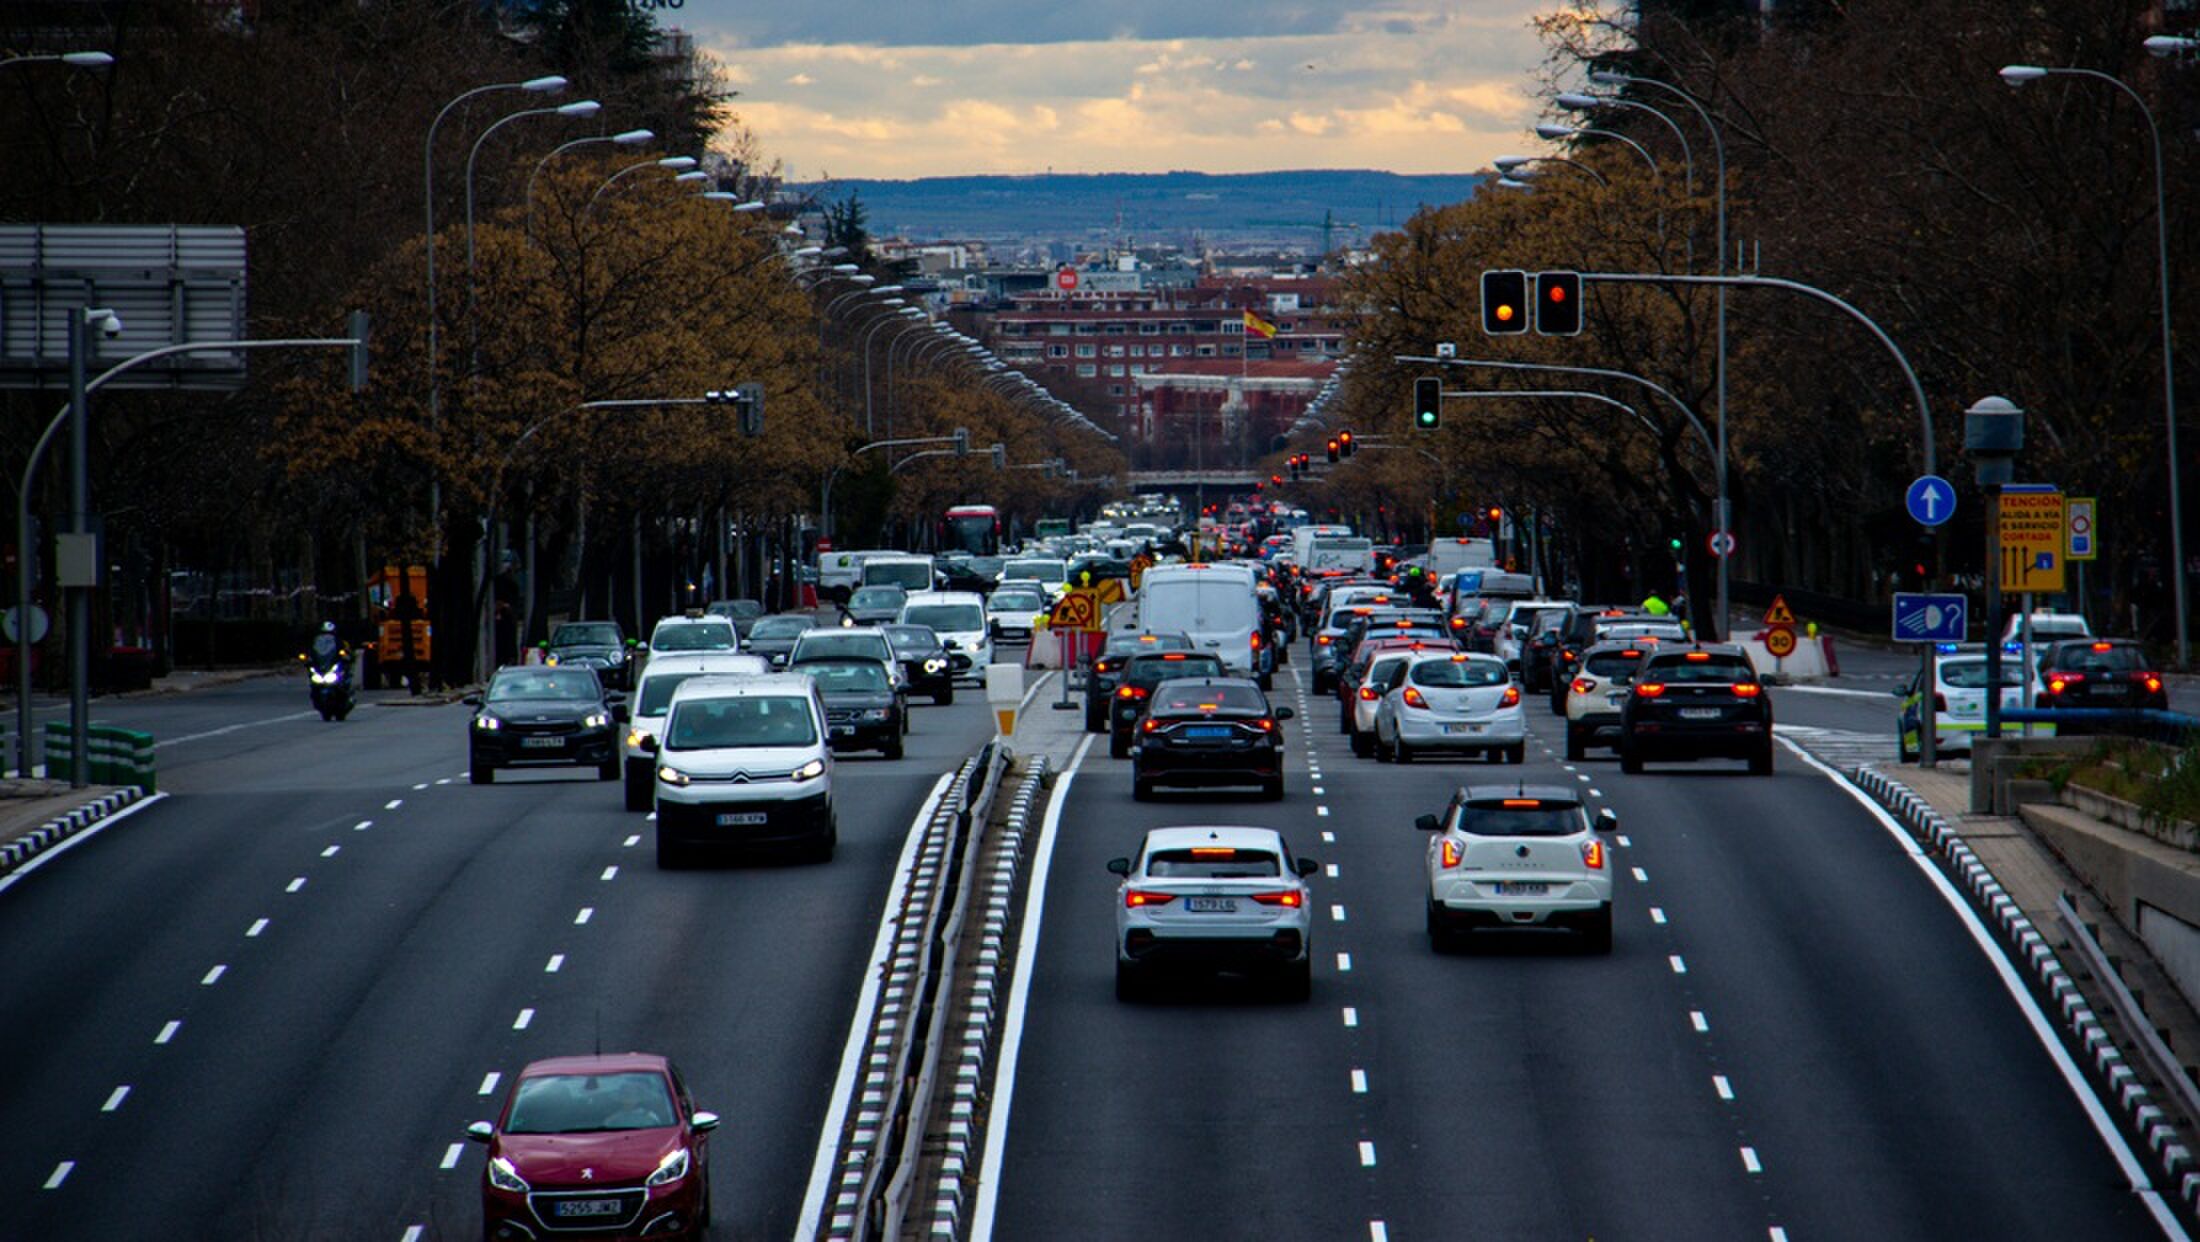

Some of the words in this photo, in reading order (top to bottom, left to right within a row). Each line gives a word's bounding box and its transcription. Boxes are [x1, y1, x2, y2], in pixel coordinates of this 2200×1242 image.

[2002, 496, 2061, 507] TENCIÓN
[2001, 511, 2031, 519] ALIDA
[2002, 532, 2052, 541] CORTADA
[1772, 636, 1789, 647] 30
